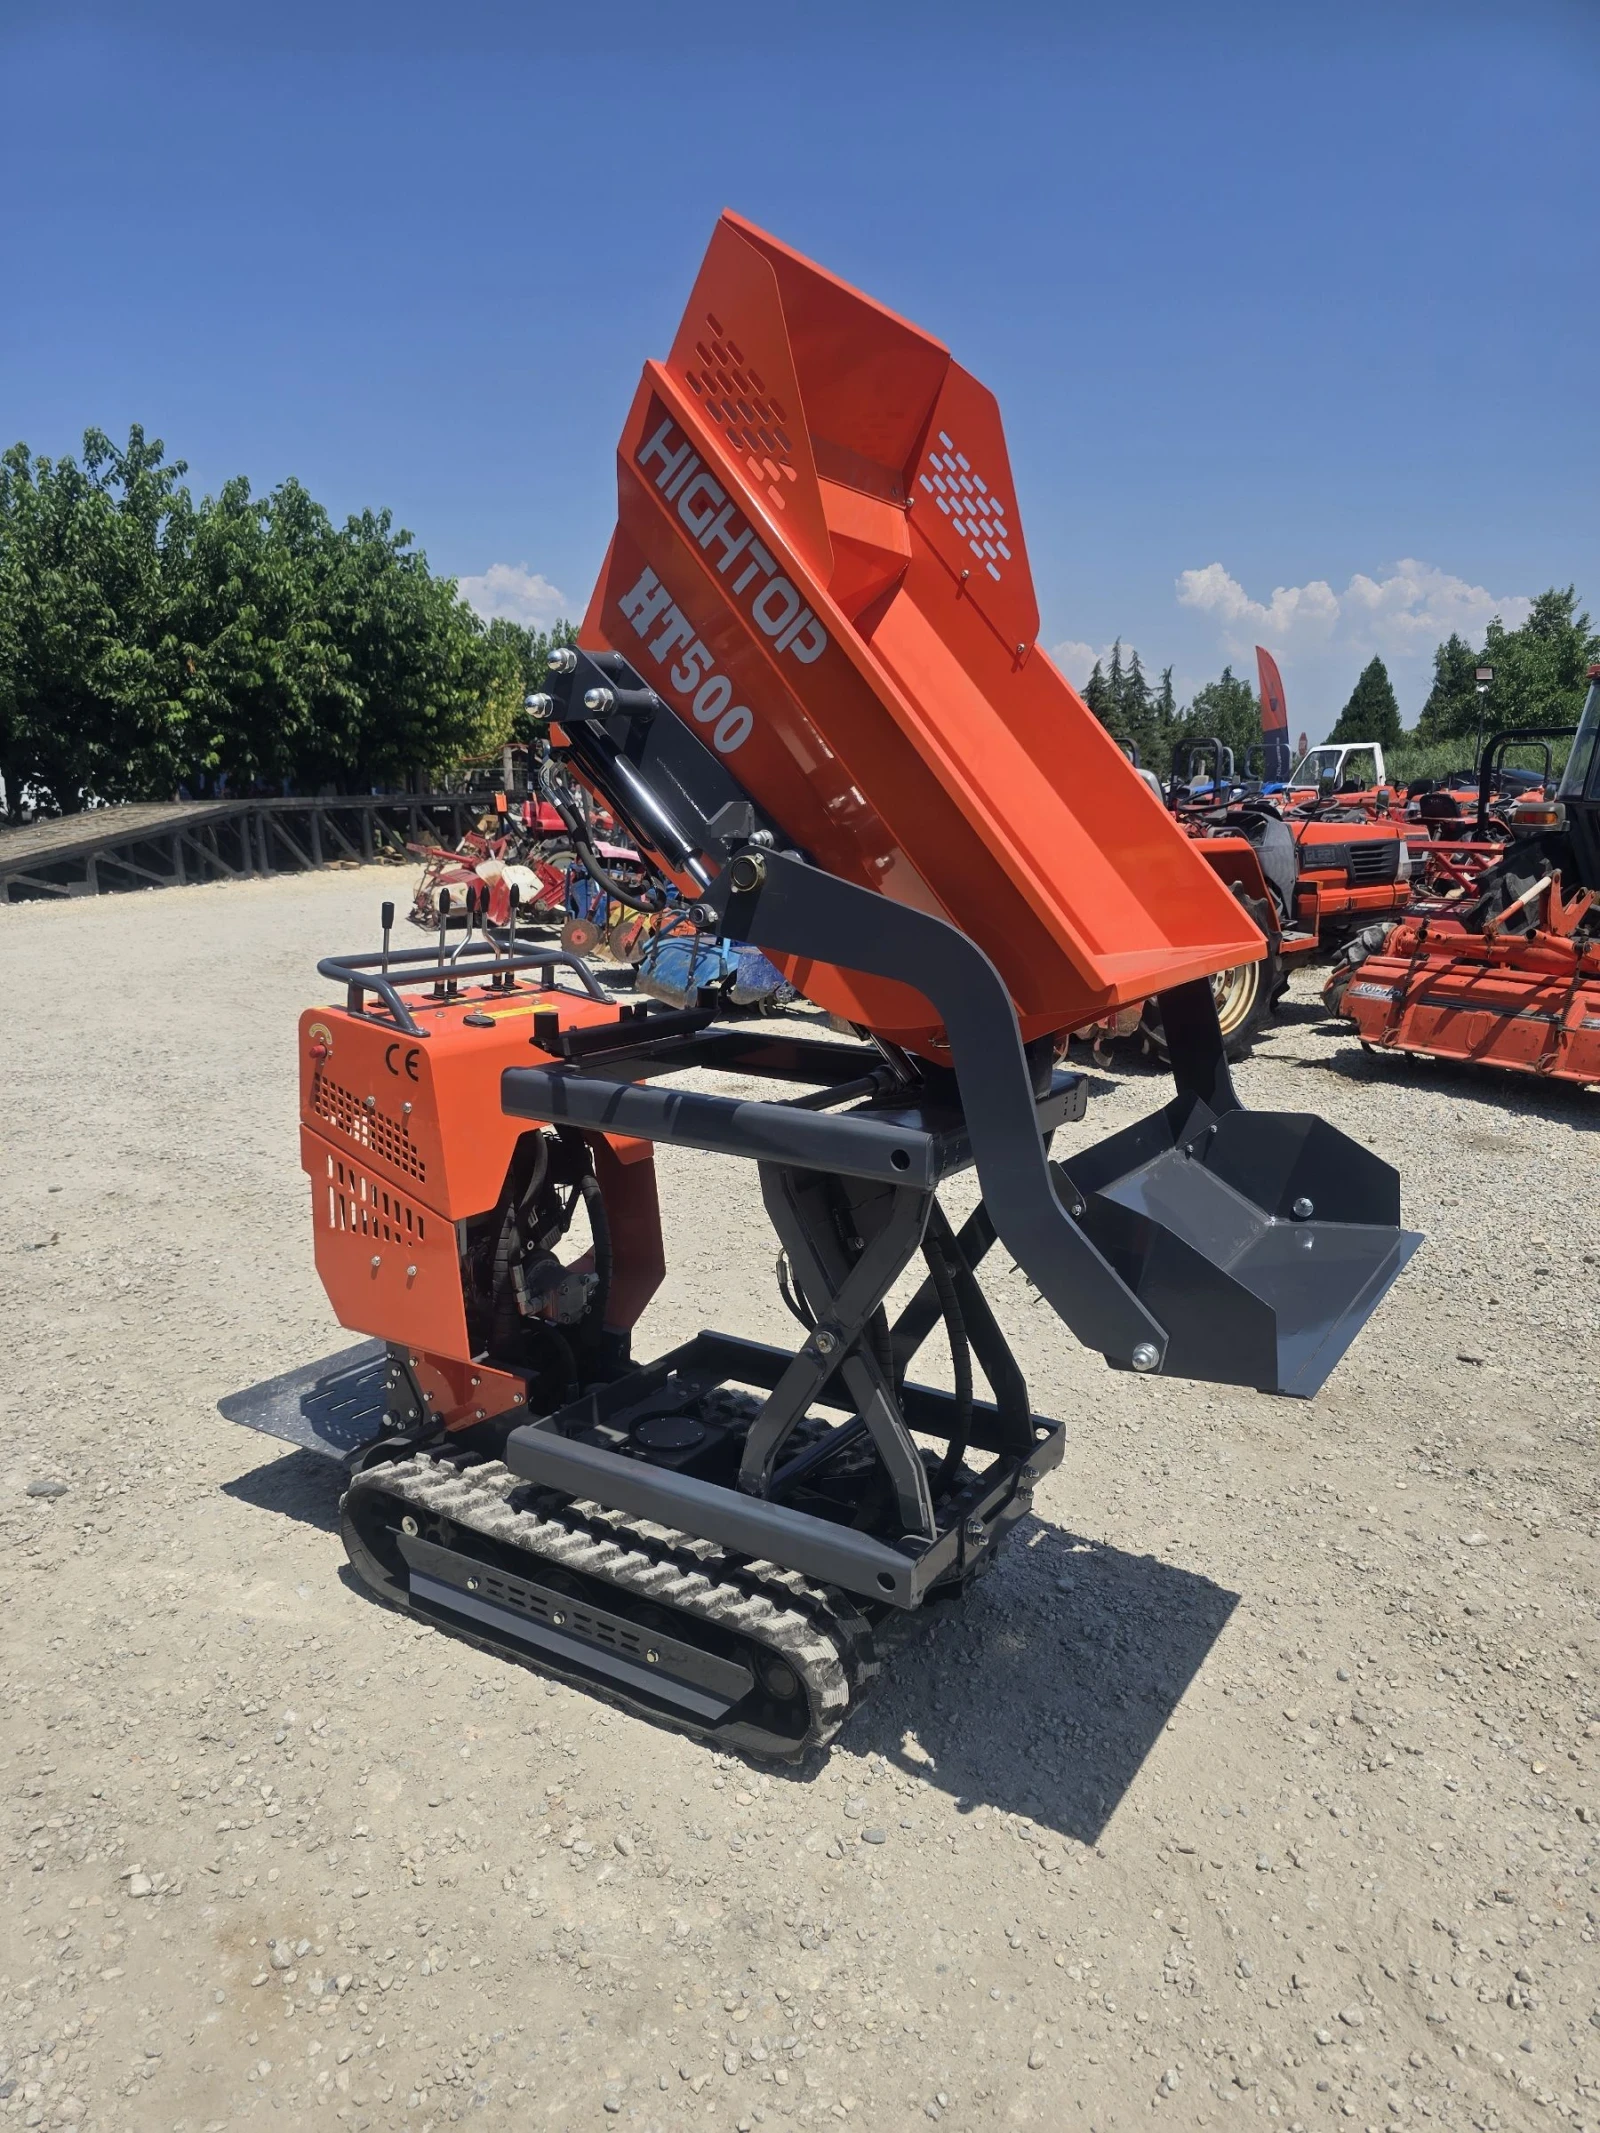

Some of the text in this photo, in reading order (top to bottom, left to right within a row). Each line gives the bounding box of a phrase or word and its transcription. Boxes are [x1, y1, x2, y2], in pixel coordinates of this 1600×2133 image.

[637, 418, 828, 664] HIGHTOP
[617, 566, 754, 754] HT500
[1359, 983, 1402, 997] Kubota
[385, 1043, 419, 1082] CE
